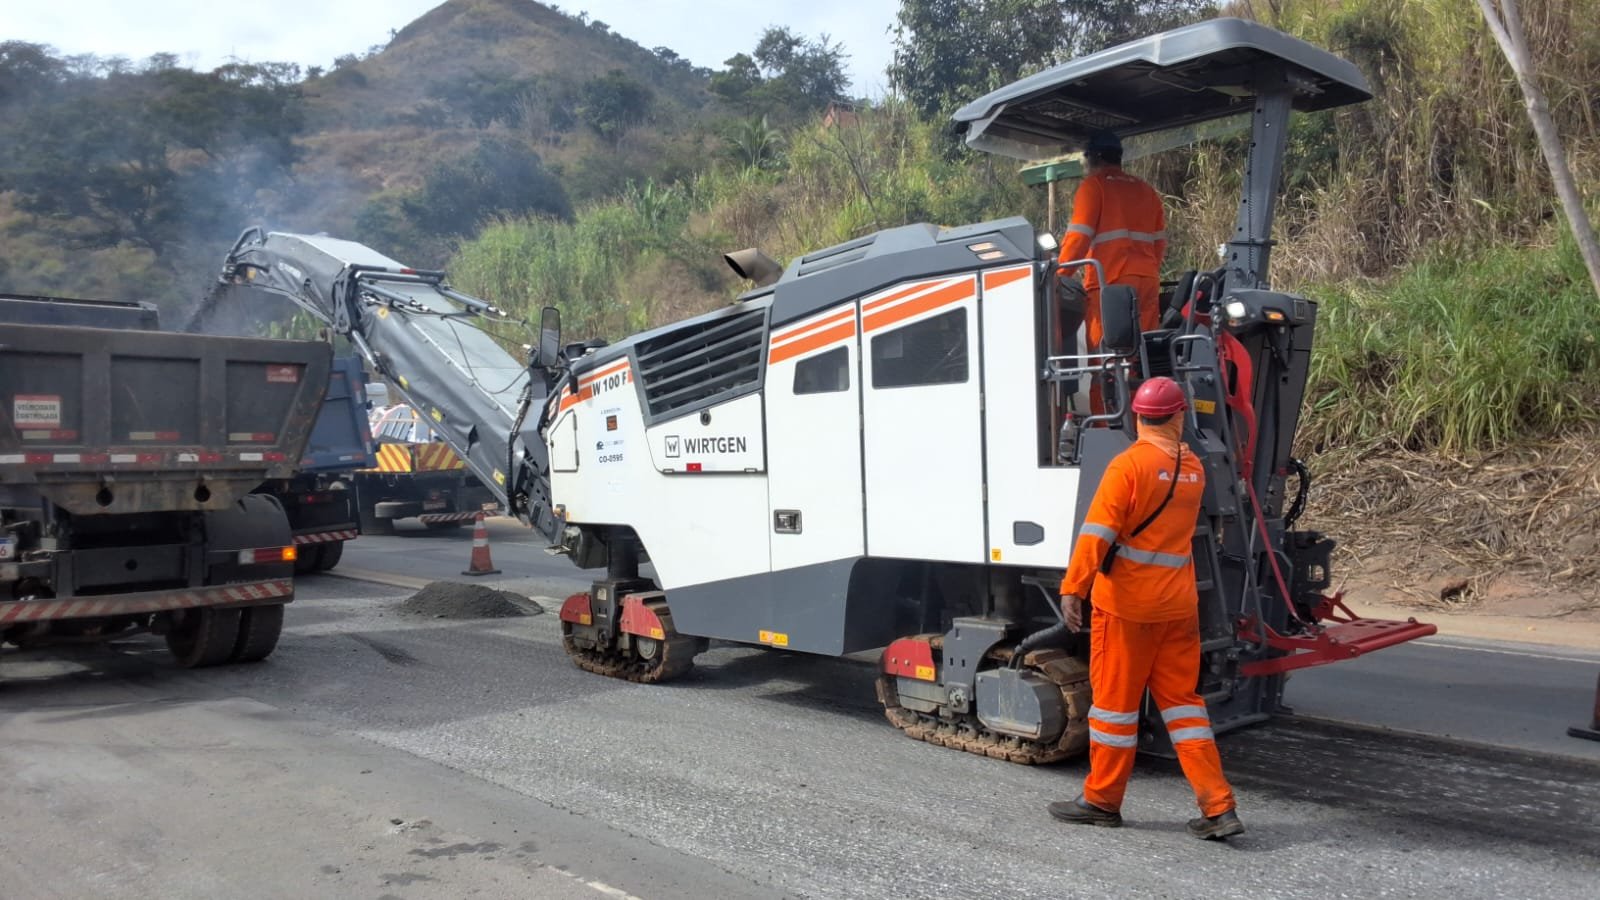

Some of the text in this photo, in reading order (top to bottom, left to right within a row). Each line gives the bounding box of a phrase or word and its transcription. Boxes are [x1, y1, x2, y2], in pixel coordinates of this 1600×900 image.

[592, 371, 627, 397] W 100 F
[683, 436, 747, 454] WIRTGEN
